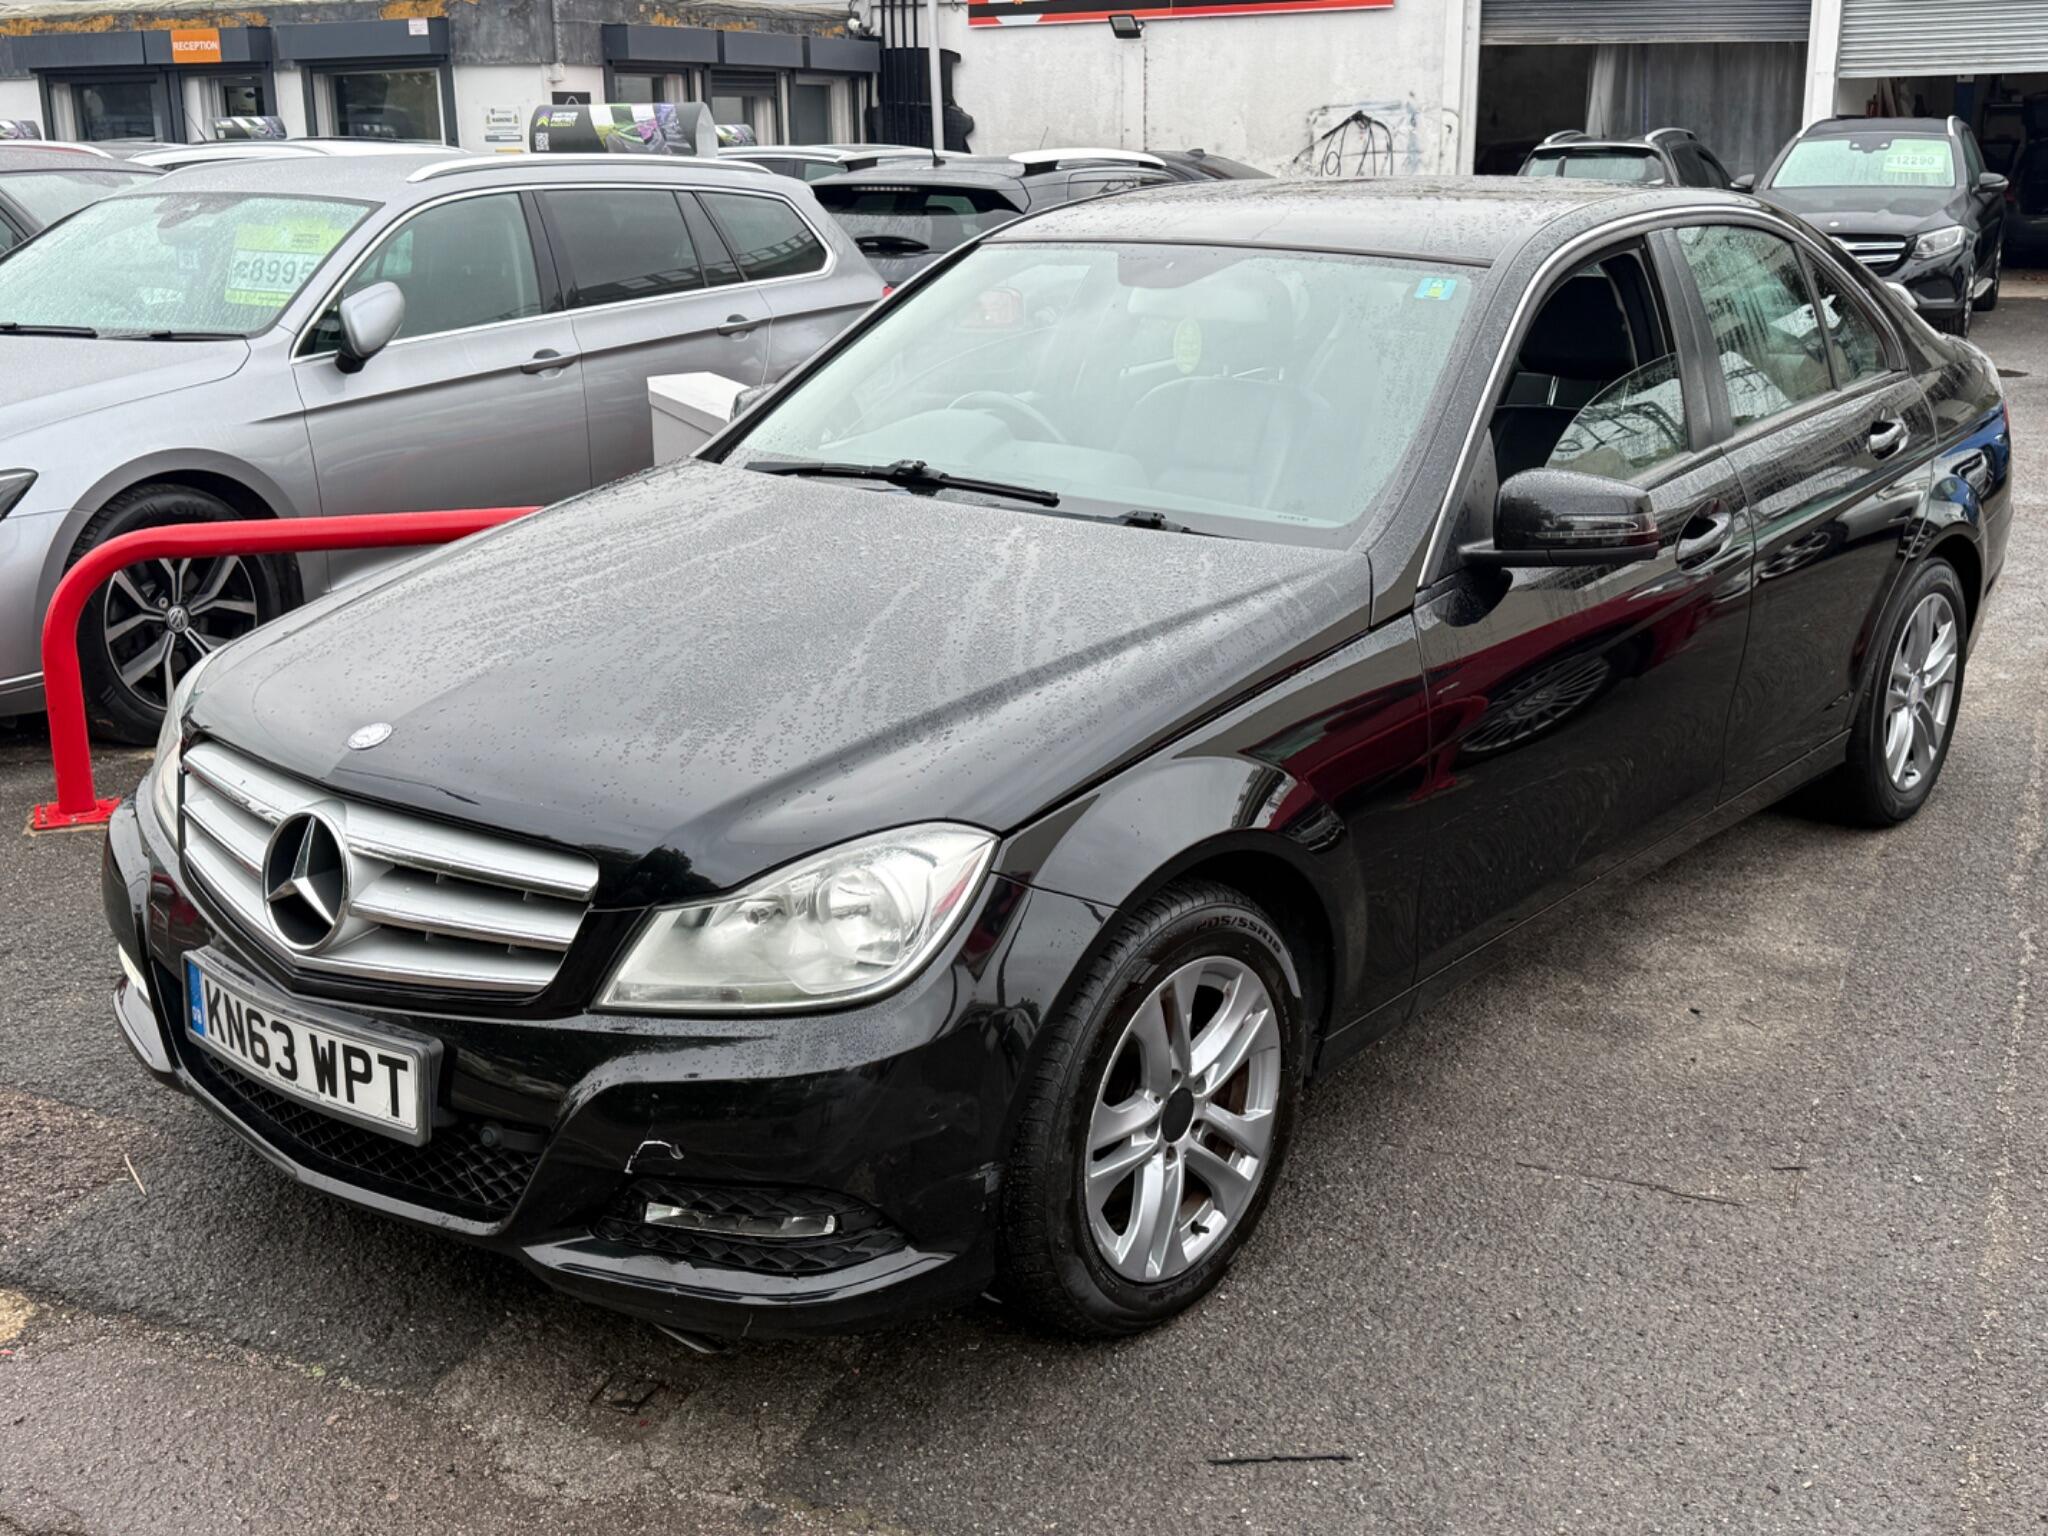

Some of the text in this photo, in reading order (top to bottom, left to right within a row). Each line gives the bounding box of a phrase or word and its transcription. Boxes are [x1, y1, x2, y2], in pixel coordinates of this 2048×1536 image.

[172, 41, 219, 51] RECEPTION
[205, 979, 408, 1119] KN63 WPT
